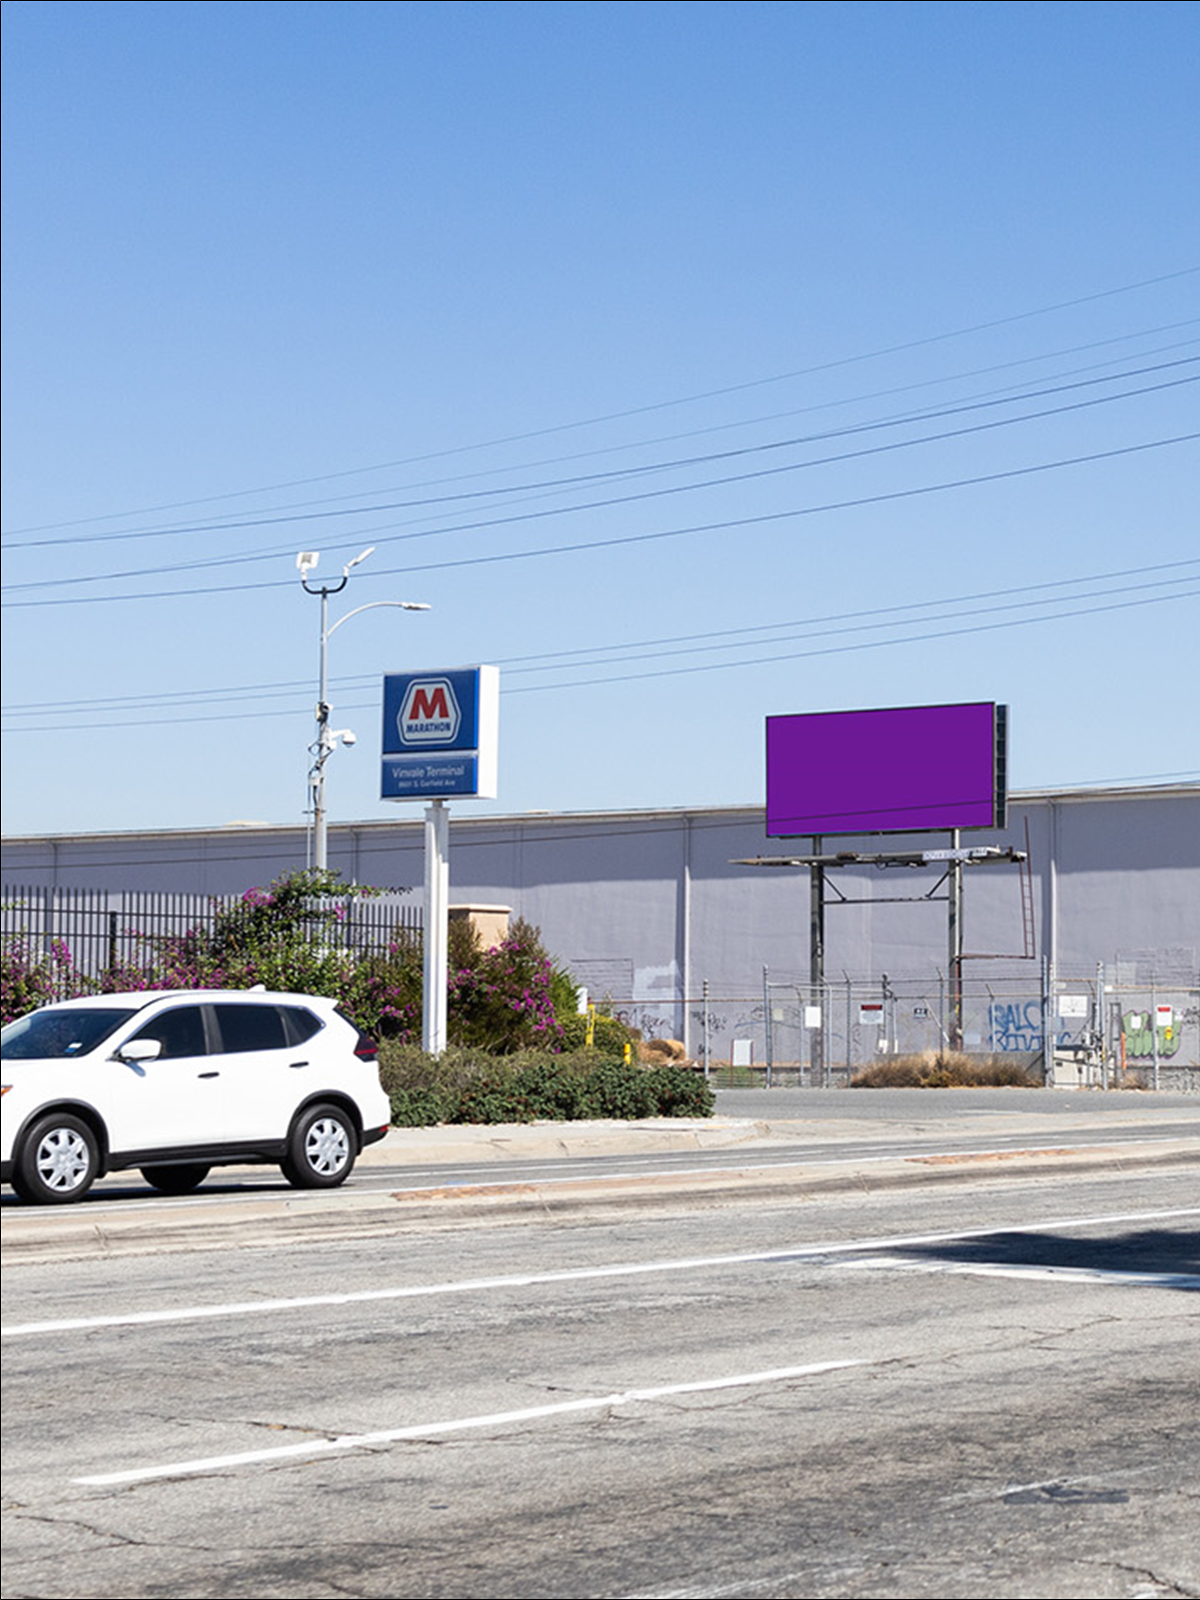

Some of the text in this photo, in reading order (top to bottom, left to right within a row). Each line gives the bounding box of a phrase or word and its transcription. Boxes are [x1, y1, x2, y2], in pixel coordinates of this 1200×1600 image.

[409, 687, 450, 720] M
[406, 722, 451, 733] MARATHON
[392, 765, 465, 778] Vinvale Terminal
